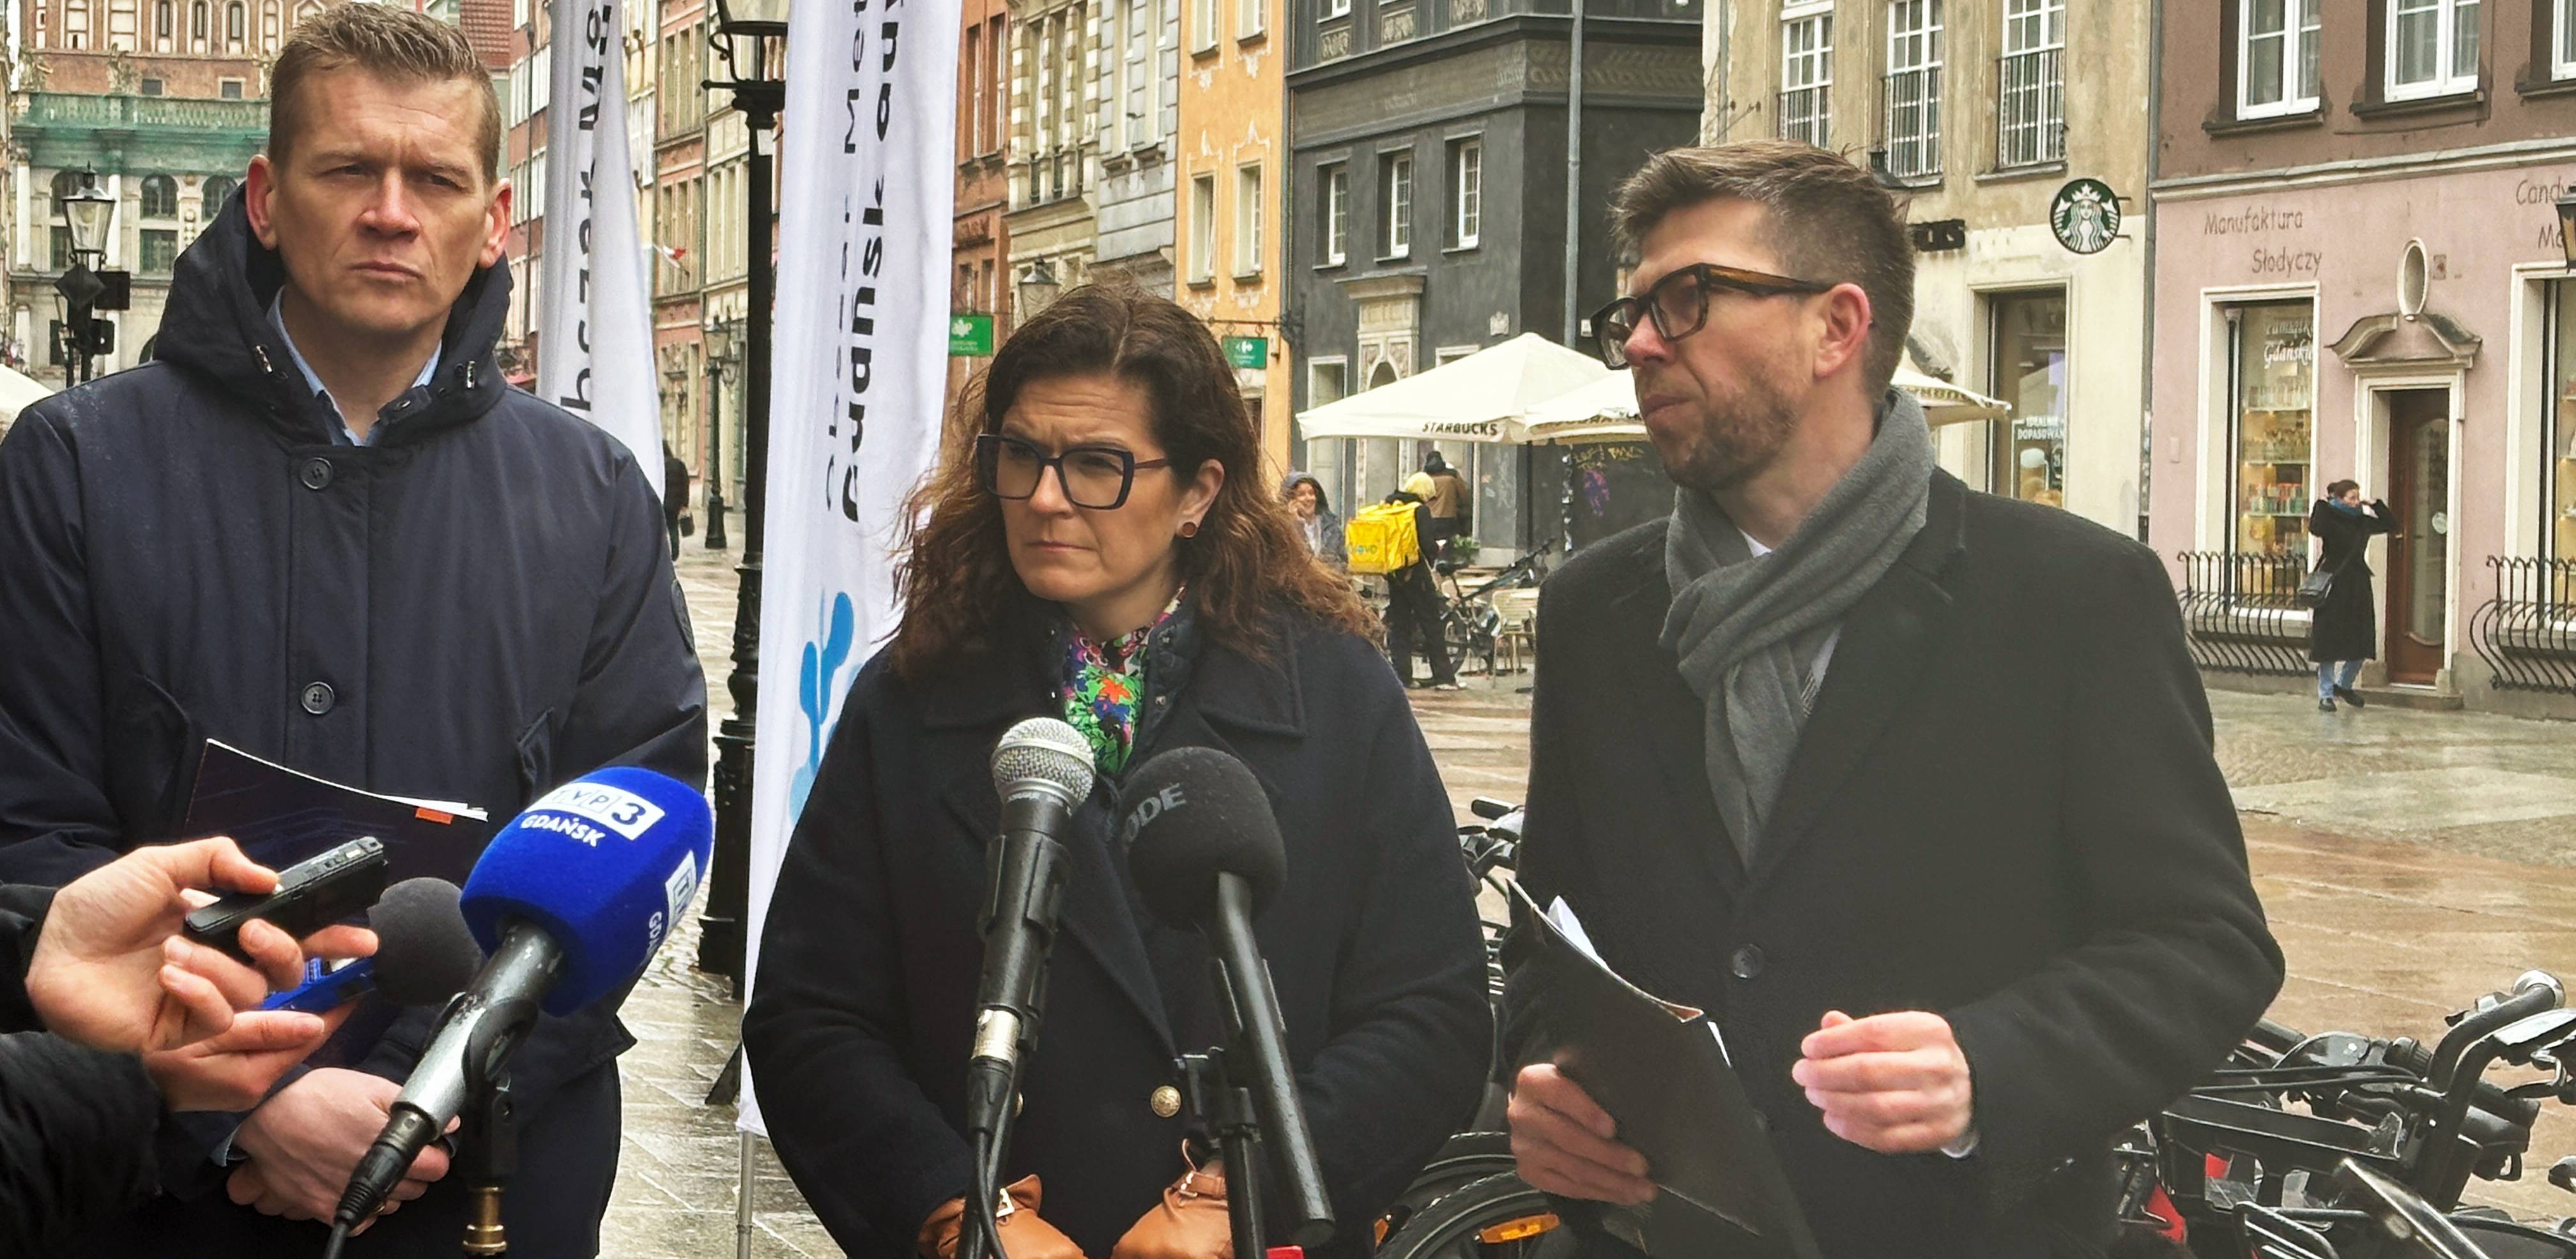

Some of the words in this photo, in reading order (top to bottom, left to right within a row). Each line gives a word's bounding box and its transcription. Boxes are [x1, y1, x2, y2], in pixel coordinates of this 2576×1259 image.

[2204, 206, 2303, 235] Manufaktura
[2252, 247, 2322, 278] Słodyczy
[1422, 422, 1498, 436] STARBUCKS
[521, 814, 606, 848] GDAŃSK
